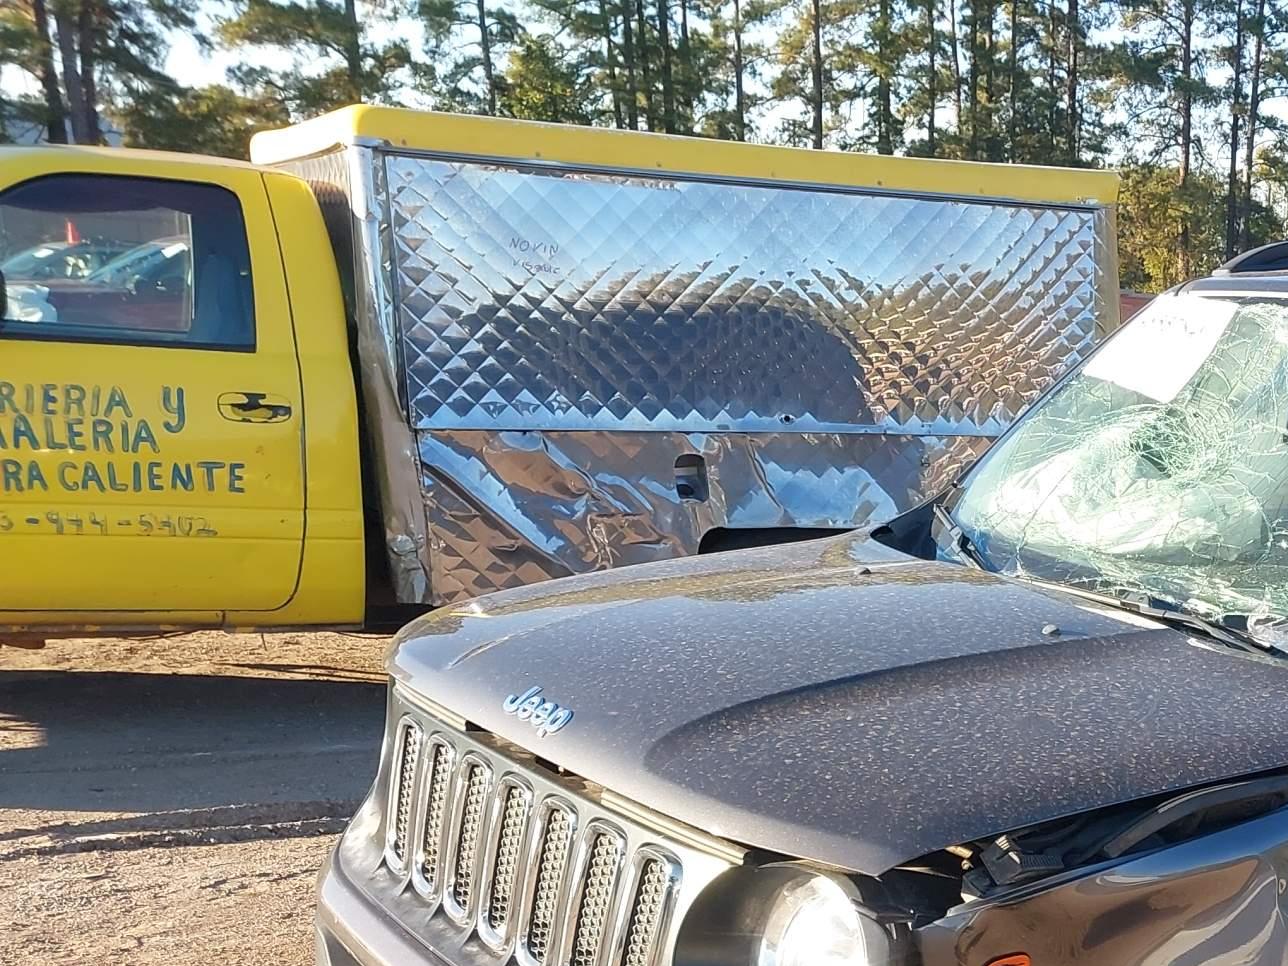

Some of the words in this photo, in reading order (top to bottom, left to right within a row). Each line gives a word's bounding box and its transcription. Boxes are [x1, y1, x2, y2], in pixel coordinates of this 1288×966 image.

[0, 414, 160, 454] ALERIA
[57, 461, 246, 494] CALIENTE
[502, 685, 575, 738] Jeep
